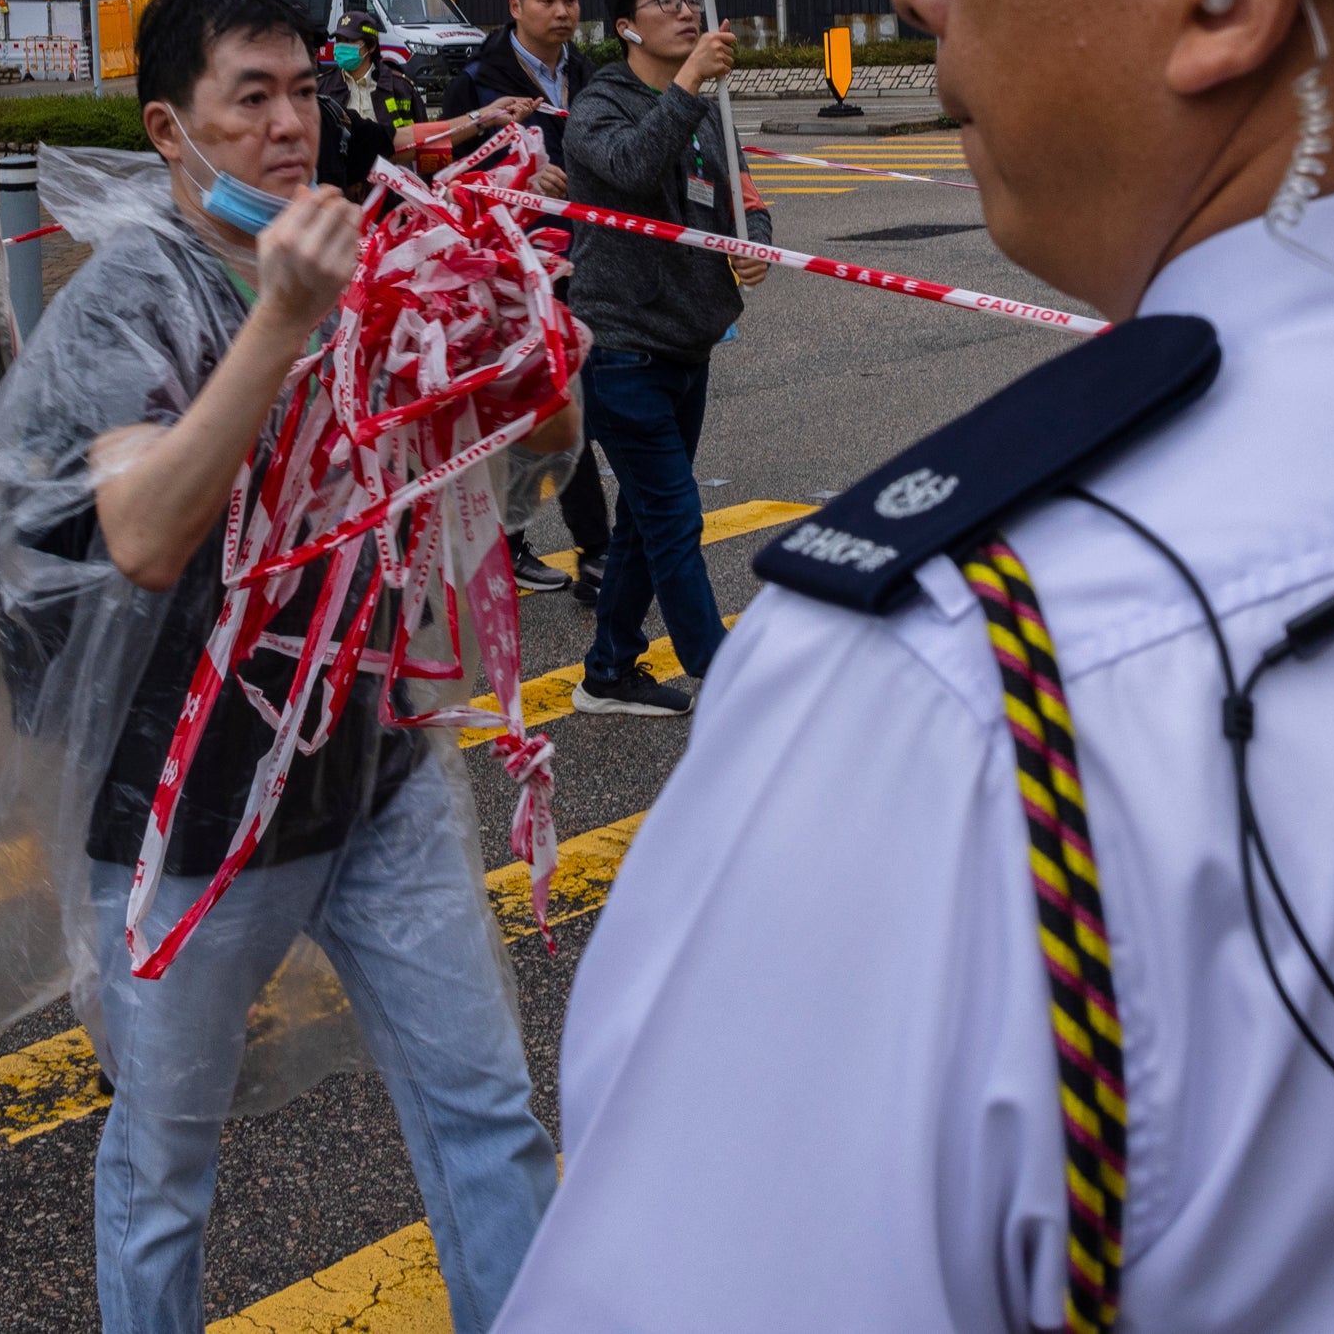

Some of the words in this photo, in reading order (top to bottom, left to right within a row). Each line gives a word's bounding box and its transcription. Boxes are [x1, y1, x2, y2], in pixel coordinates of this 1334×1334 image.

[477, 186, 543, 209] CAUTION
[585, 210, 657, 235] SAFE
[703, 235, 782, 262] CAUTION
[835, 264, 920, 293] SAFE
[976, 296, 1072, 325] CAUTION
[417, 433, 507, 488] CAUTION
[367, 474, 392, 573] CATION
